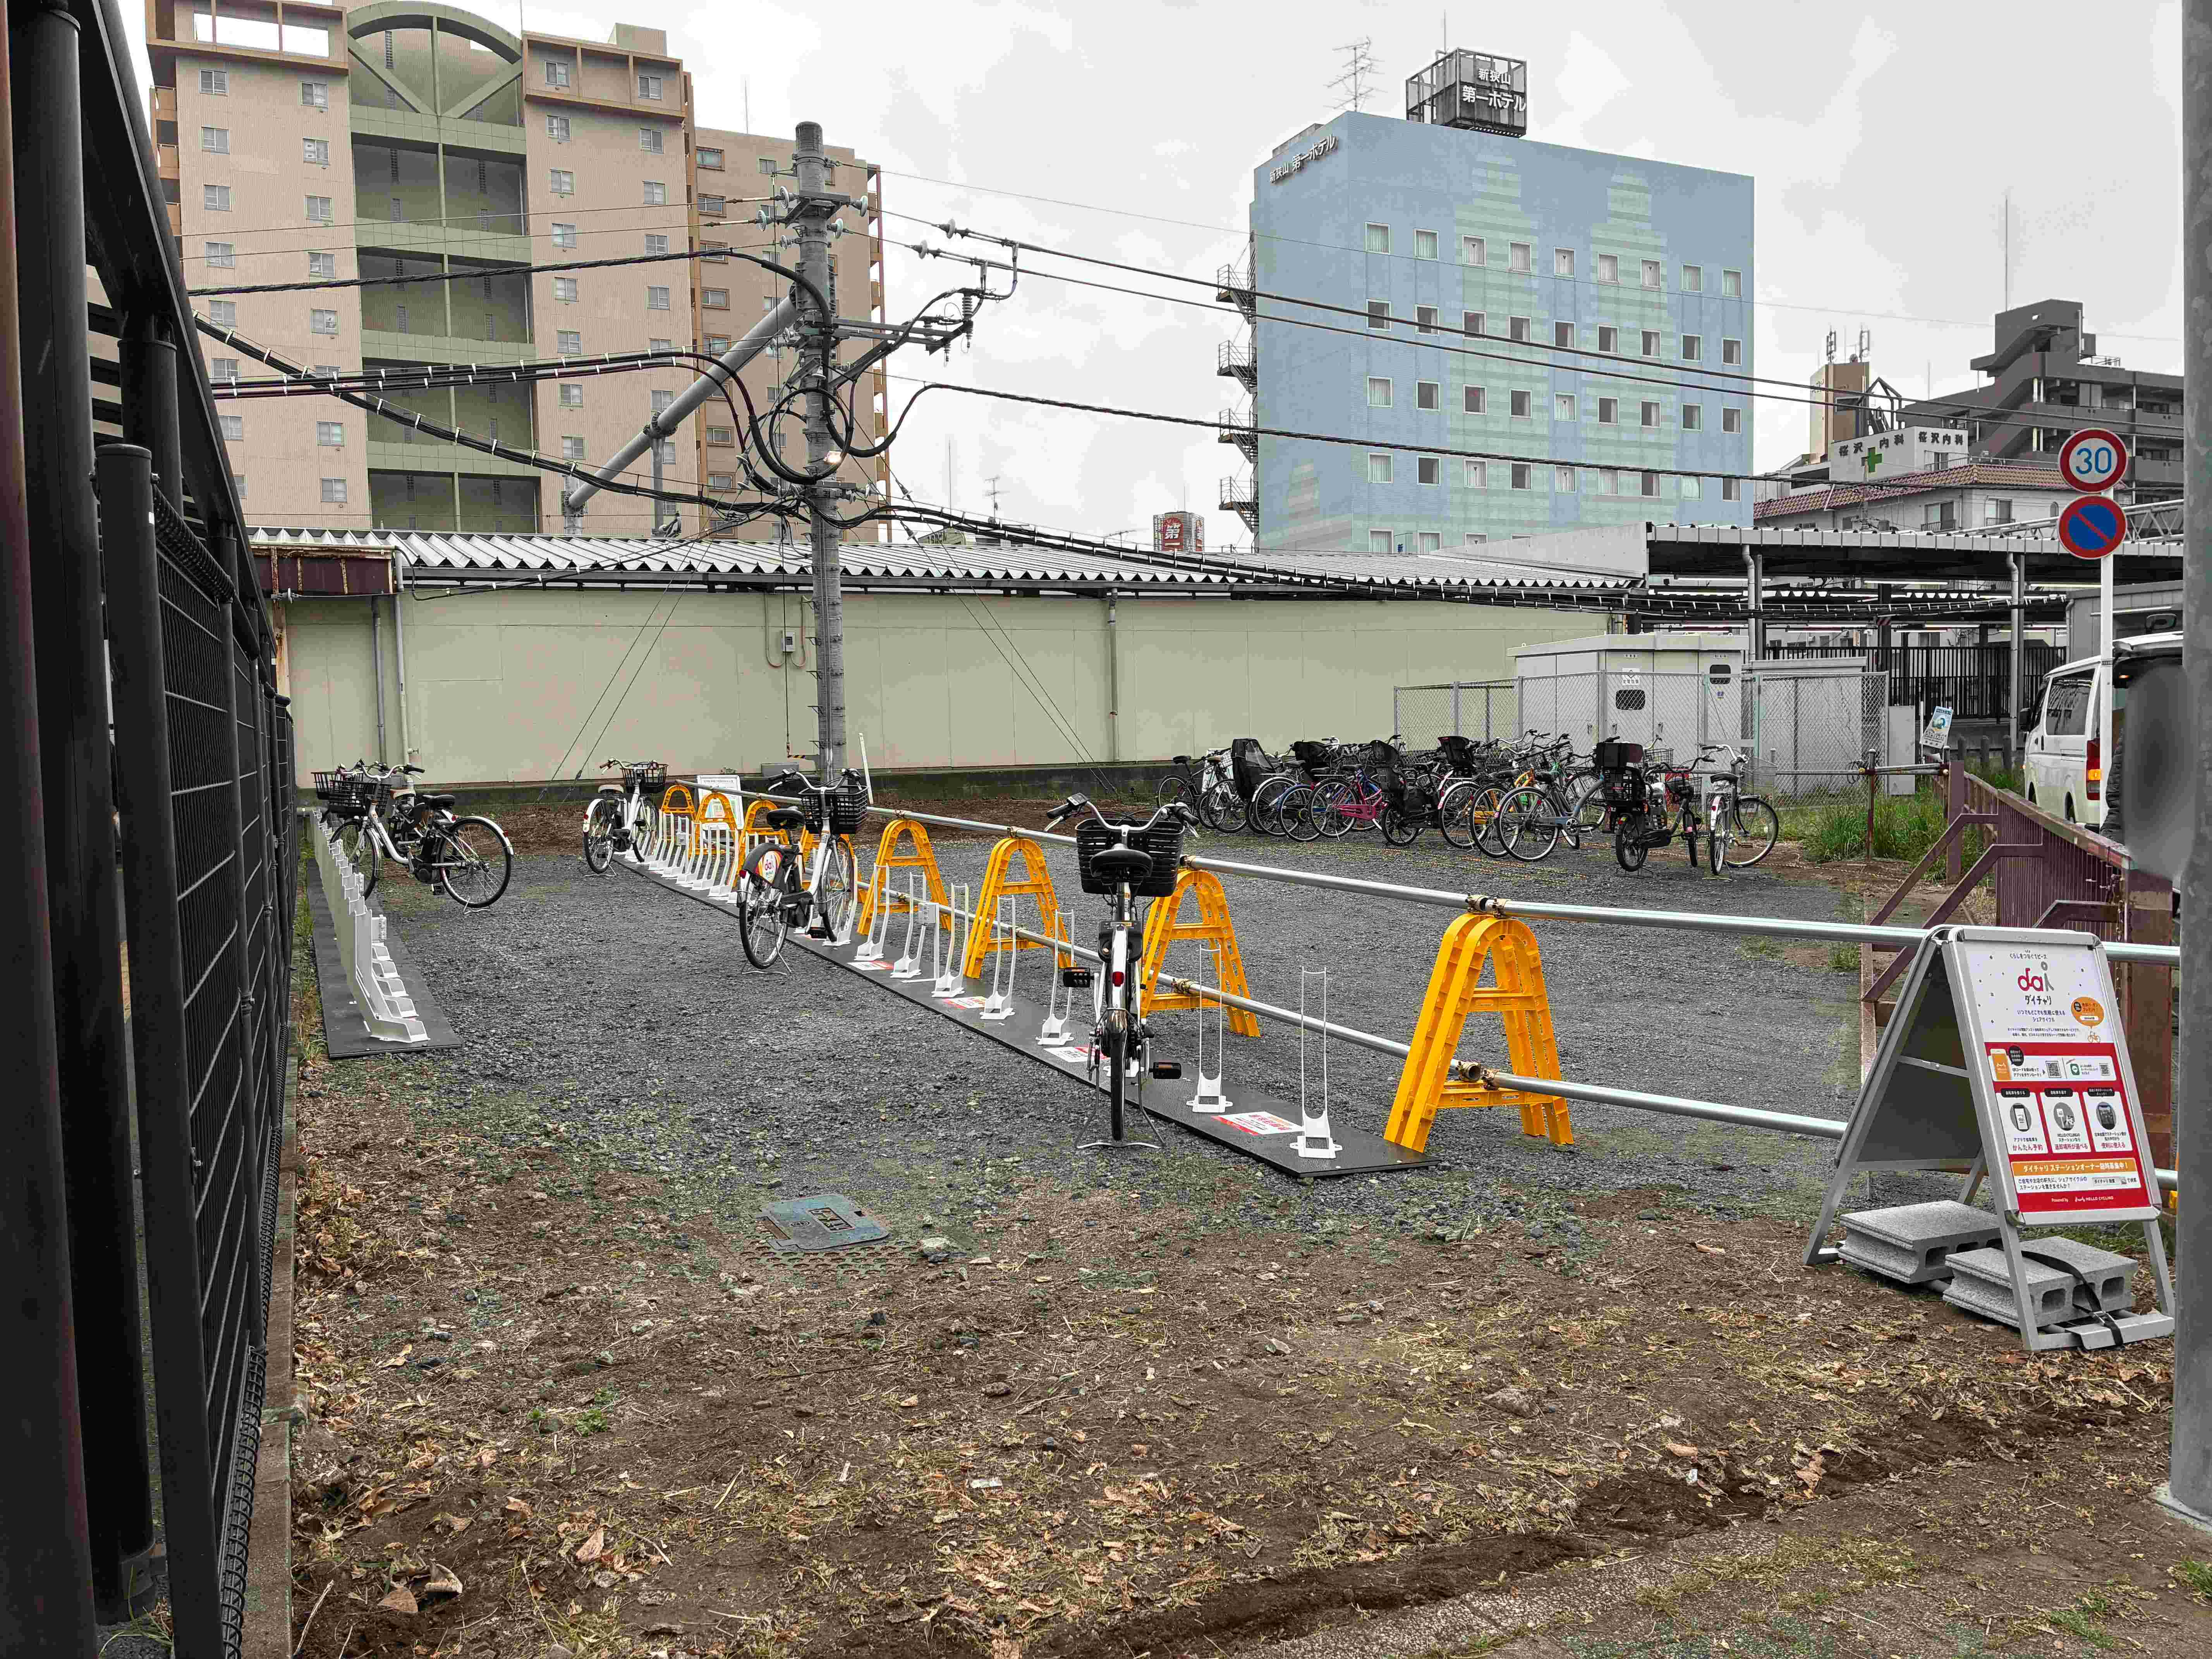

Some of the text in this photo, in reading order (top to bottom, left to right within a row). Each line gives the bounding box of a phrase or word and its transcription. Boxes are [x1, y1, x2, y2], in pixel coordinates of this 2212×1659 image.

[1478, 68, 1511, 85] 新狭山
[1462, 85, 1526, 112] 第一ホテル
[1292, 134, 1336, 172] 第一ホテル
[2075, 446, 2112, 475] 30
[2025, 995, 2052, 1005] ダイチャリ
[2023, 1164, 2049, 1172] ダイチャリ
